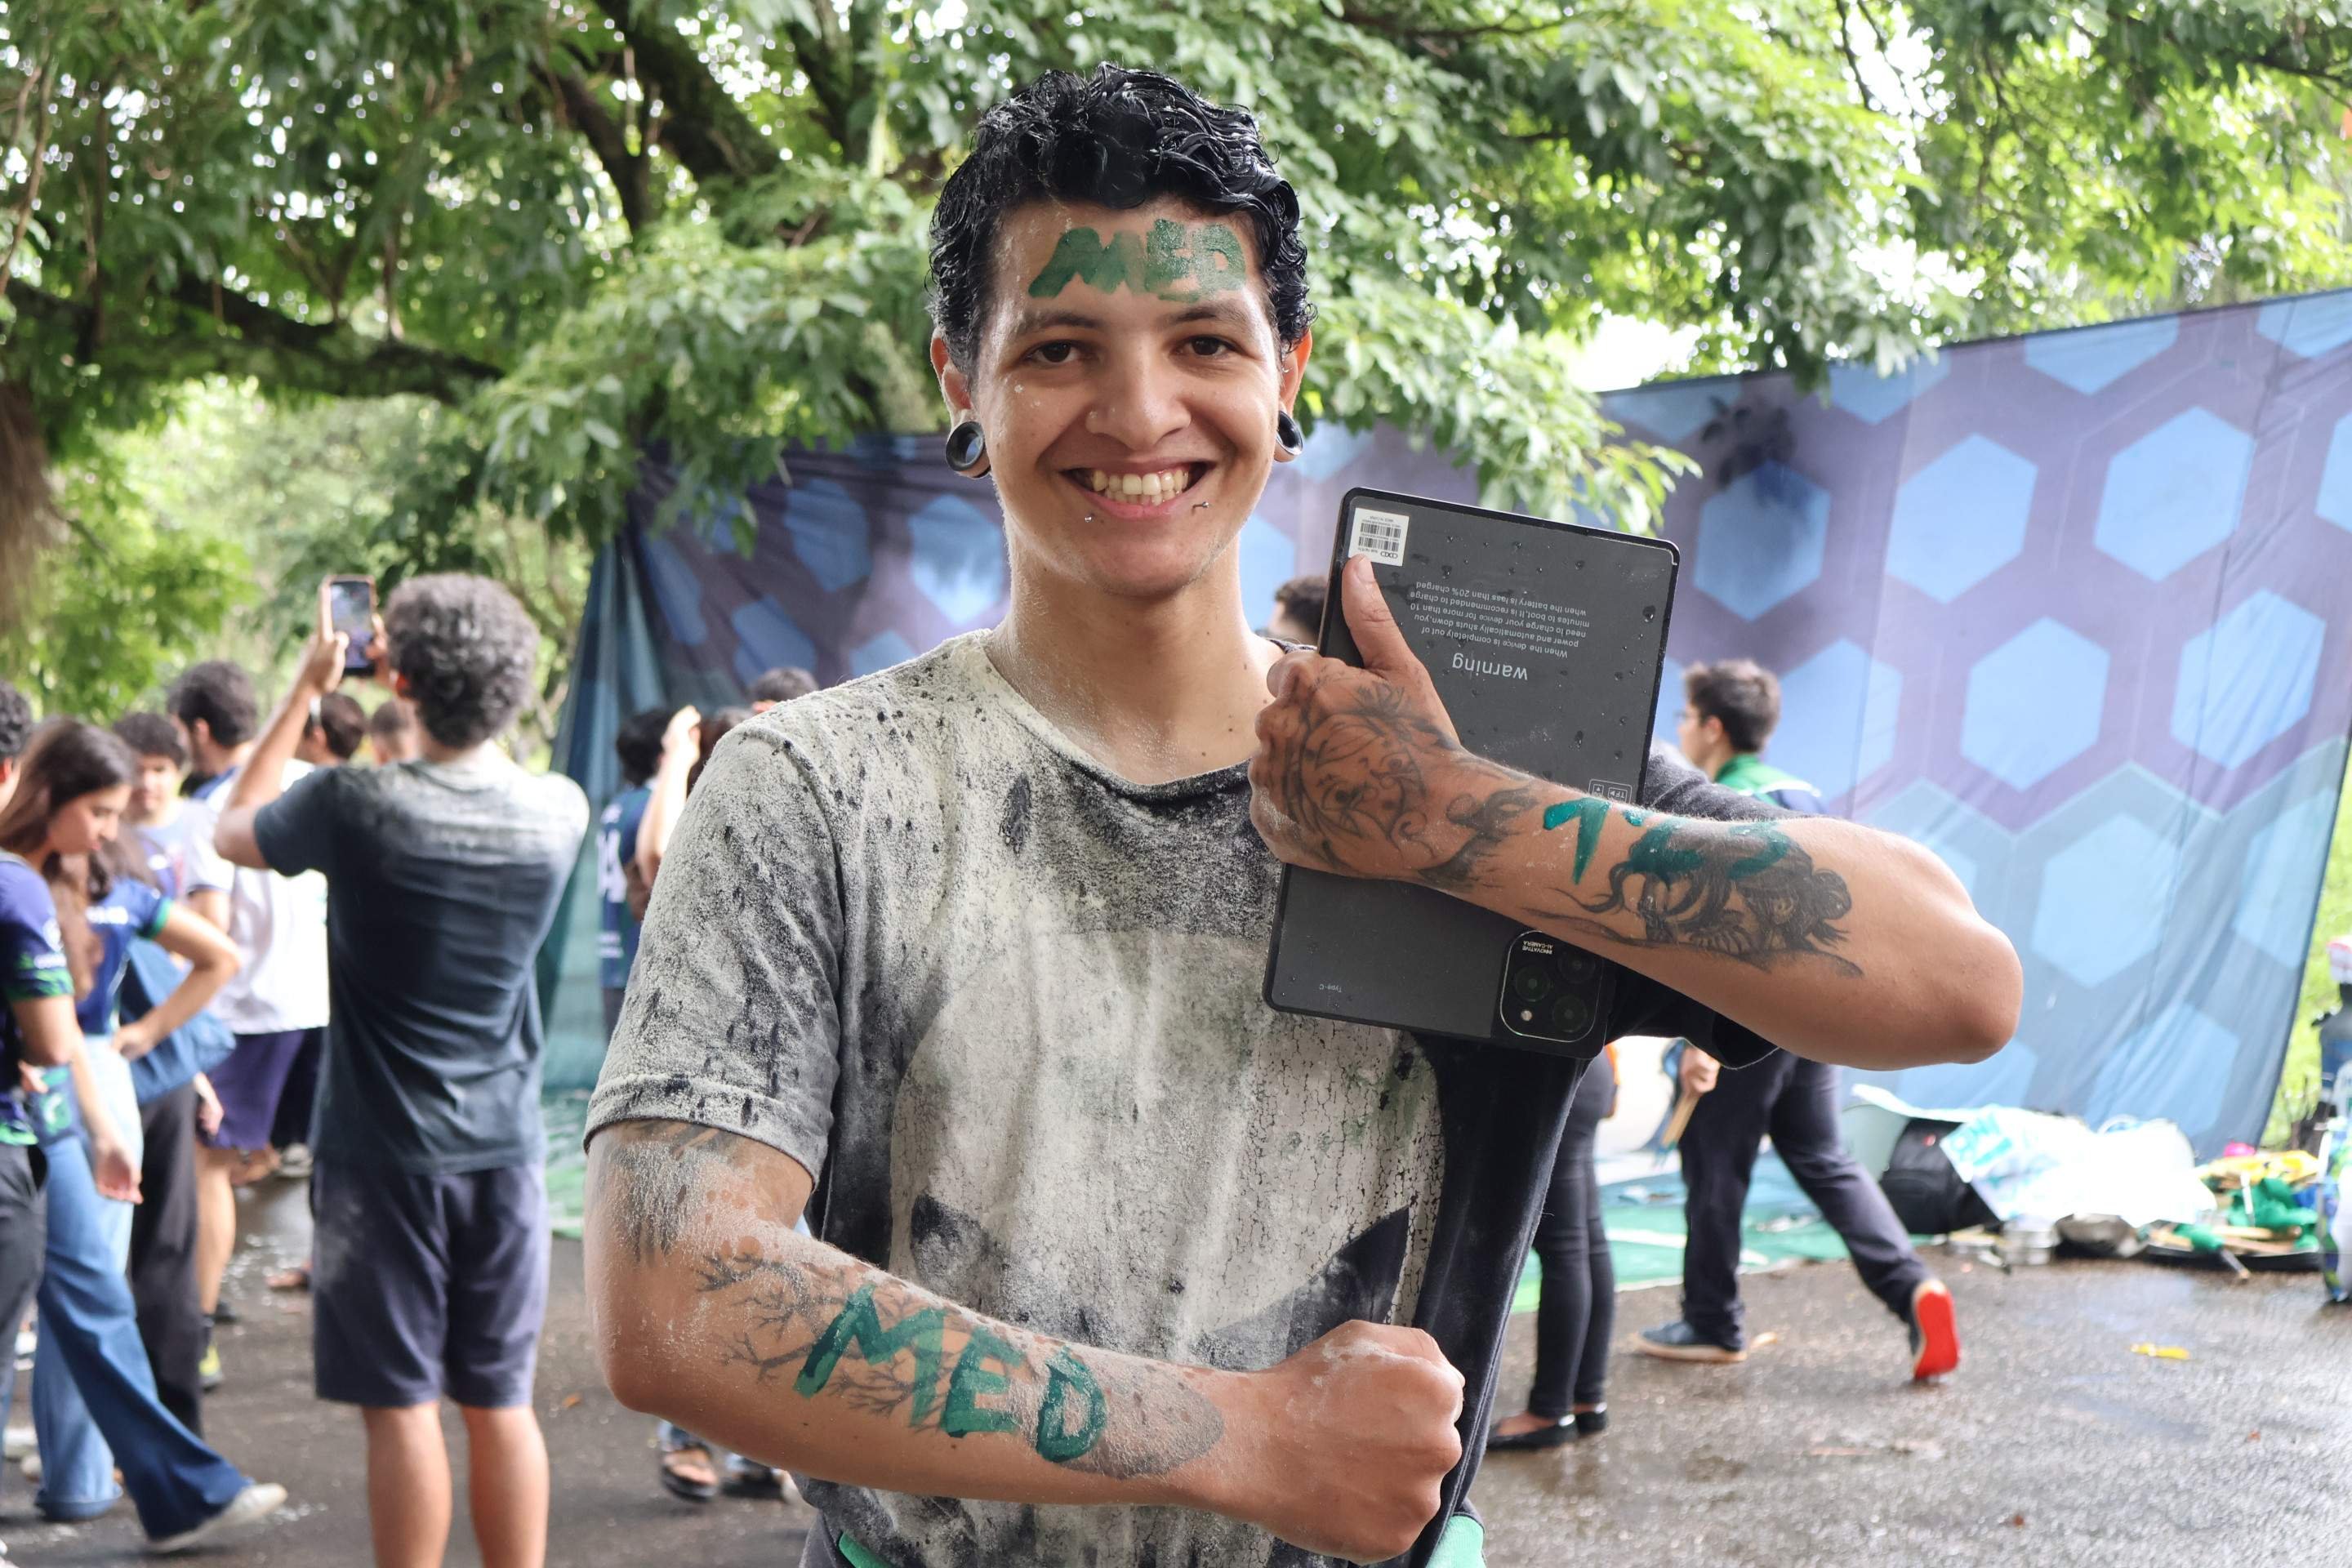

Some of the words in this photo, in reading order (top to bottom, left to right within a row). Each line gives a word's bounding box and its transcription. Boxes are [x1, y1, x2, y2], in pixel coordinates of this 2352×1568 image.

[1028, 219, 1246, 303] MED
[1416, 581, 1450, 594] charged
[1452, 587, 1470, 597] 20%
[1410, 590, 1439, 603] charge
[1472, 591, 1490, 601] than
[1410, 603, 1419, 611] 10
[1450, 598, 1508, 613] recommended
[1510, 598, 1517, 606] is
[1518, 598, 1548, 611] battery
[1423, 604, 1441, 614] than
[1442, 608, 1463, 617] more
[1510, 608, 1517, 617] is
[1549, 604, 1562, 613] the
[1565, 607, 1586, 617] when
[1464, 612, 1477, 621] for
[1479, 614, 1503, 625] device
[1455, 621, 1478, 631] shuts
[1505, 618, 1524, 627] your
[1526, 621, 1554, 633] charge
[1557, 617, 1589, 628] minutes
[1446, 629, 1491, 644] completely
[1479, 624, 1535, 639] automatically
[1556, 627, 1564, 636] to
[1566, 629, 1586, 638] need
[1494, 639, 1500, 647] is
[1536, 635, 1552, 643] and
[1552, 638, 1579, 648] power
[1502, 640, 1526, 651] device
[1530, 645, 1542, 653] the
[1544, 648, 1567, 658] When
[1452, 653, 1527, 680] warning
[791, 1283, 1108, 1463] MED
